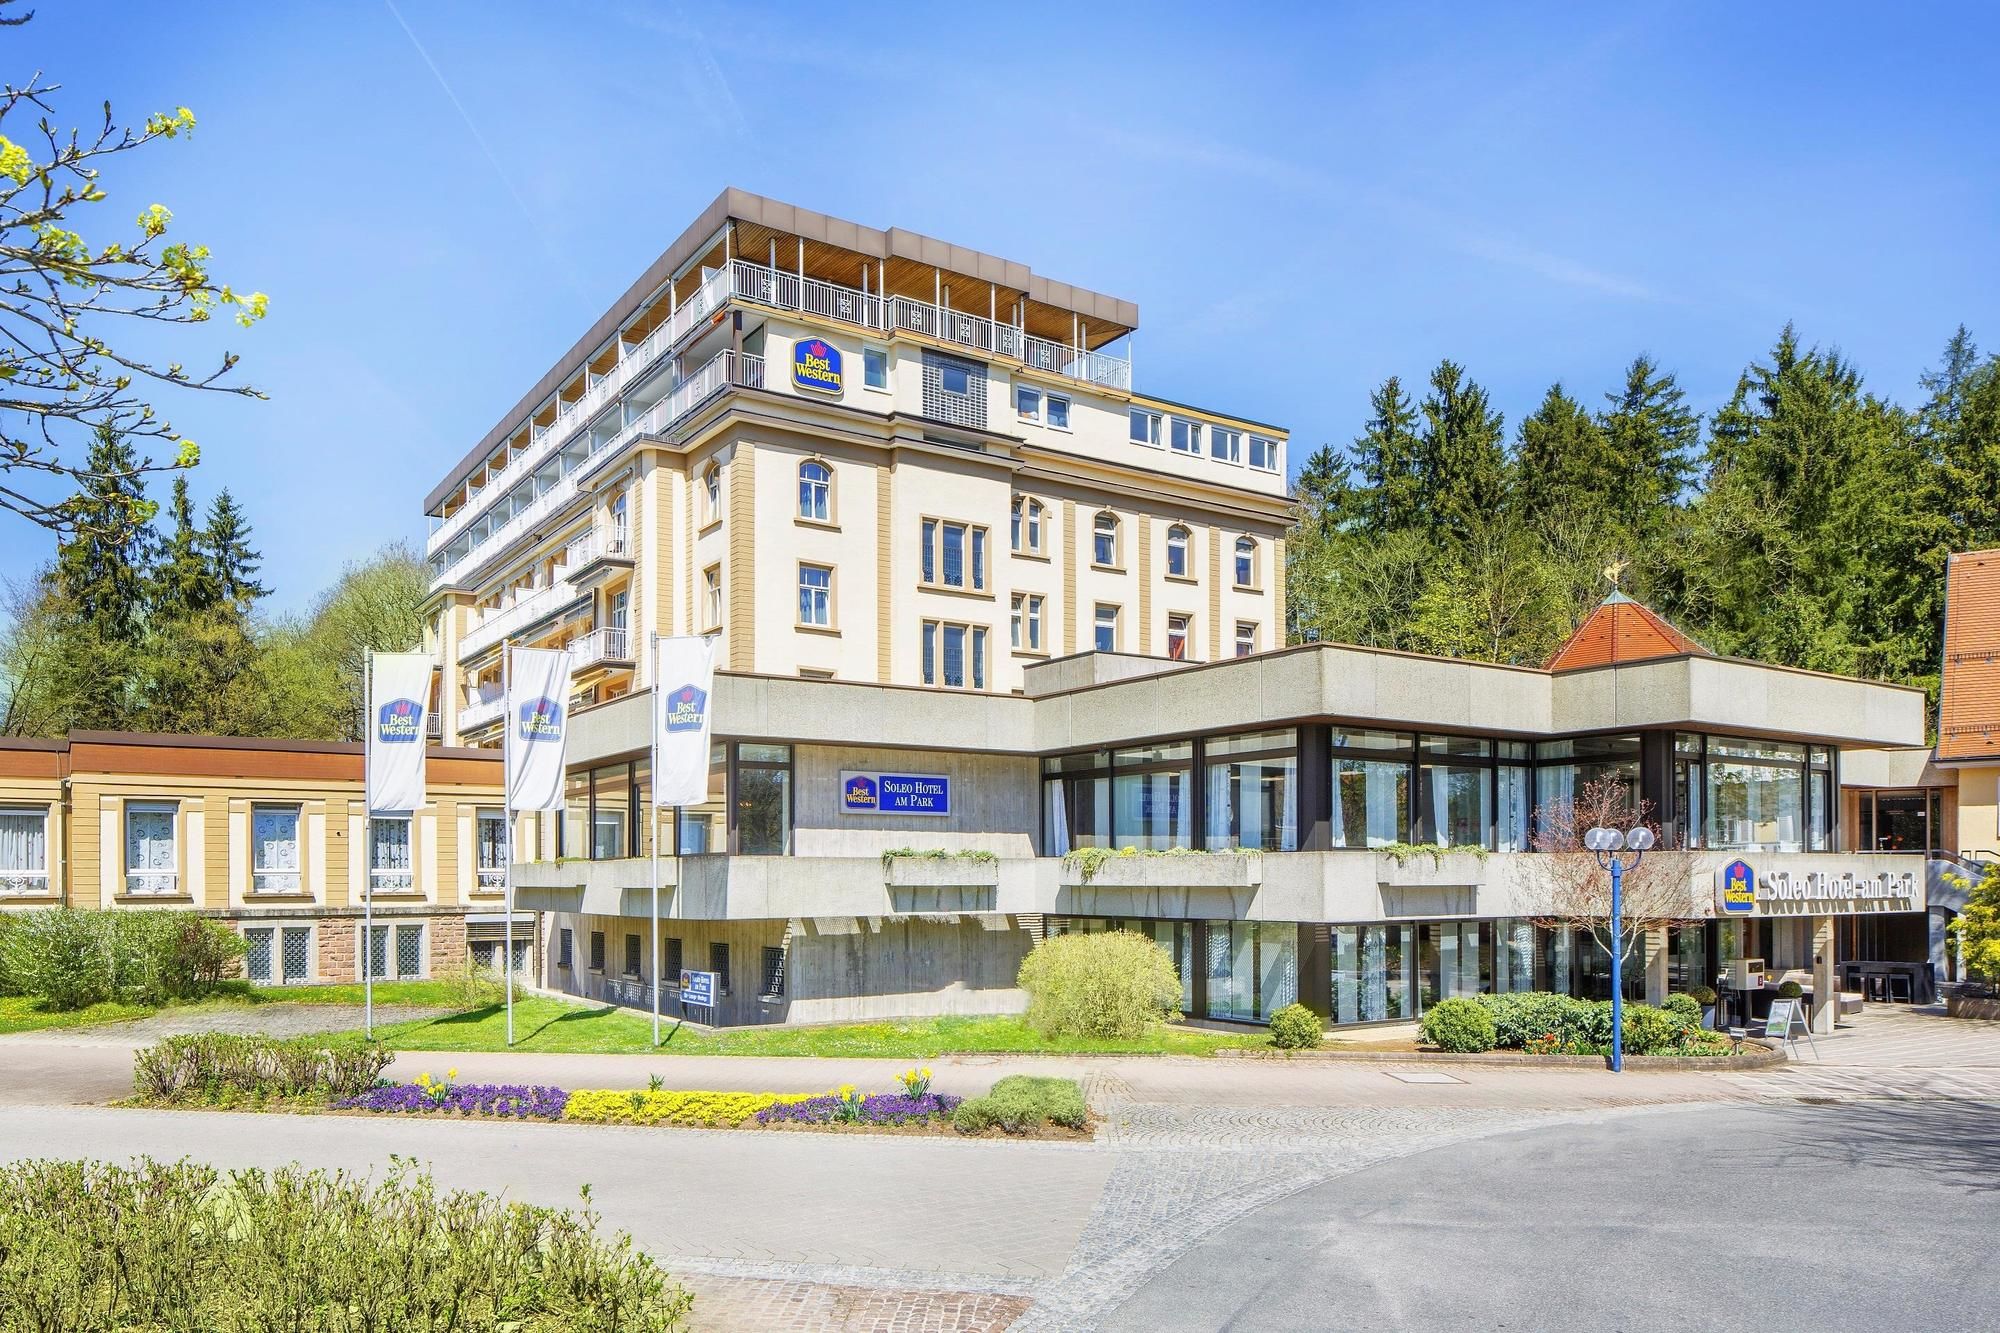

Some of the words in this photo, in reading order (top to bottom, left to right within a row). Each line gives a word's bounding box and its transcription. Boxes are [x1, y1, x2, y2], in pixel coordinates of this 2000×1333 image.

[805, 353, 830, 370] Best
[796, 363, 840, 384] Western
[677, 700, 696, 714] Best
[389, 714, 413, 725] Best
[853, 787, 869, 796] Best
[884, 781, 912, 793] SOLEO
[915, 782, 943, 794] HOTEL
[847, 794, 876, 803] Western
[910, 795, 933, 807] PARK
[1731, 878, 1747, 891] Best
[1768, 872, 1812, 900] Soleo
[1817, 872, 1856, 900] Hotel
[1862, 881, 1881, 898] am
[1888, 872, 1918, 898] Park
[1724, 889, 1754, 903] Western
